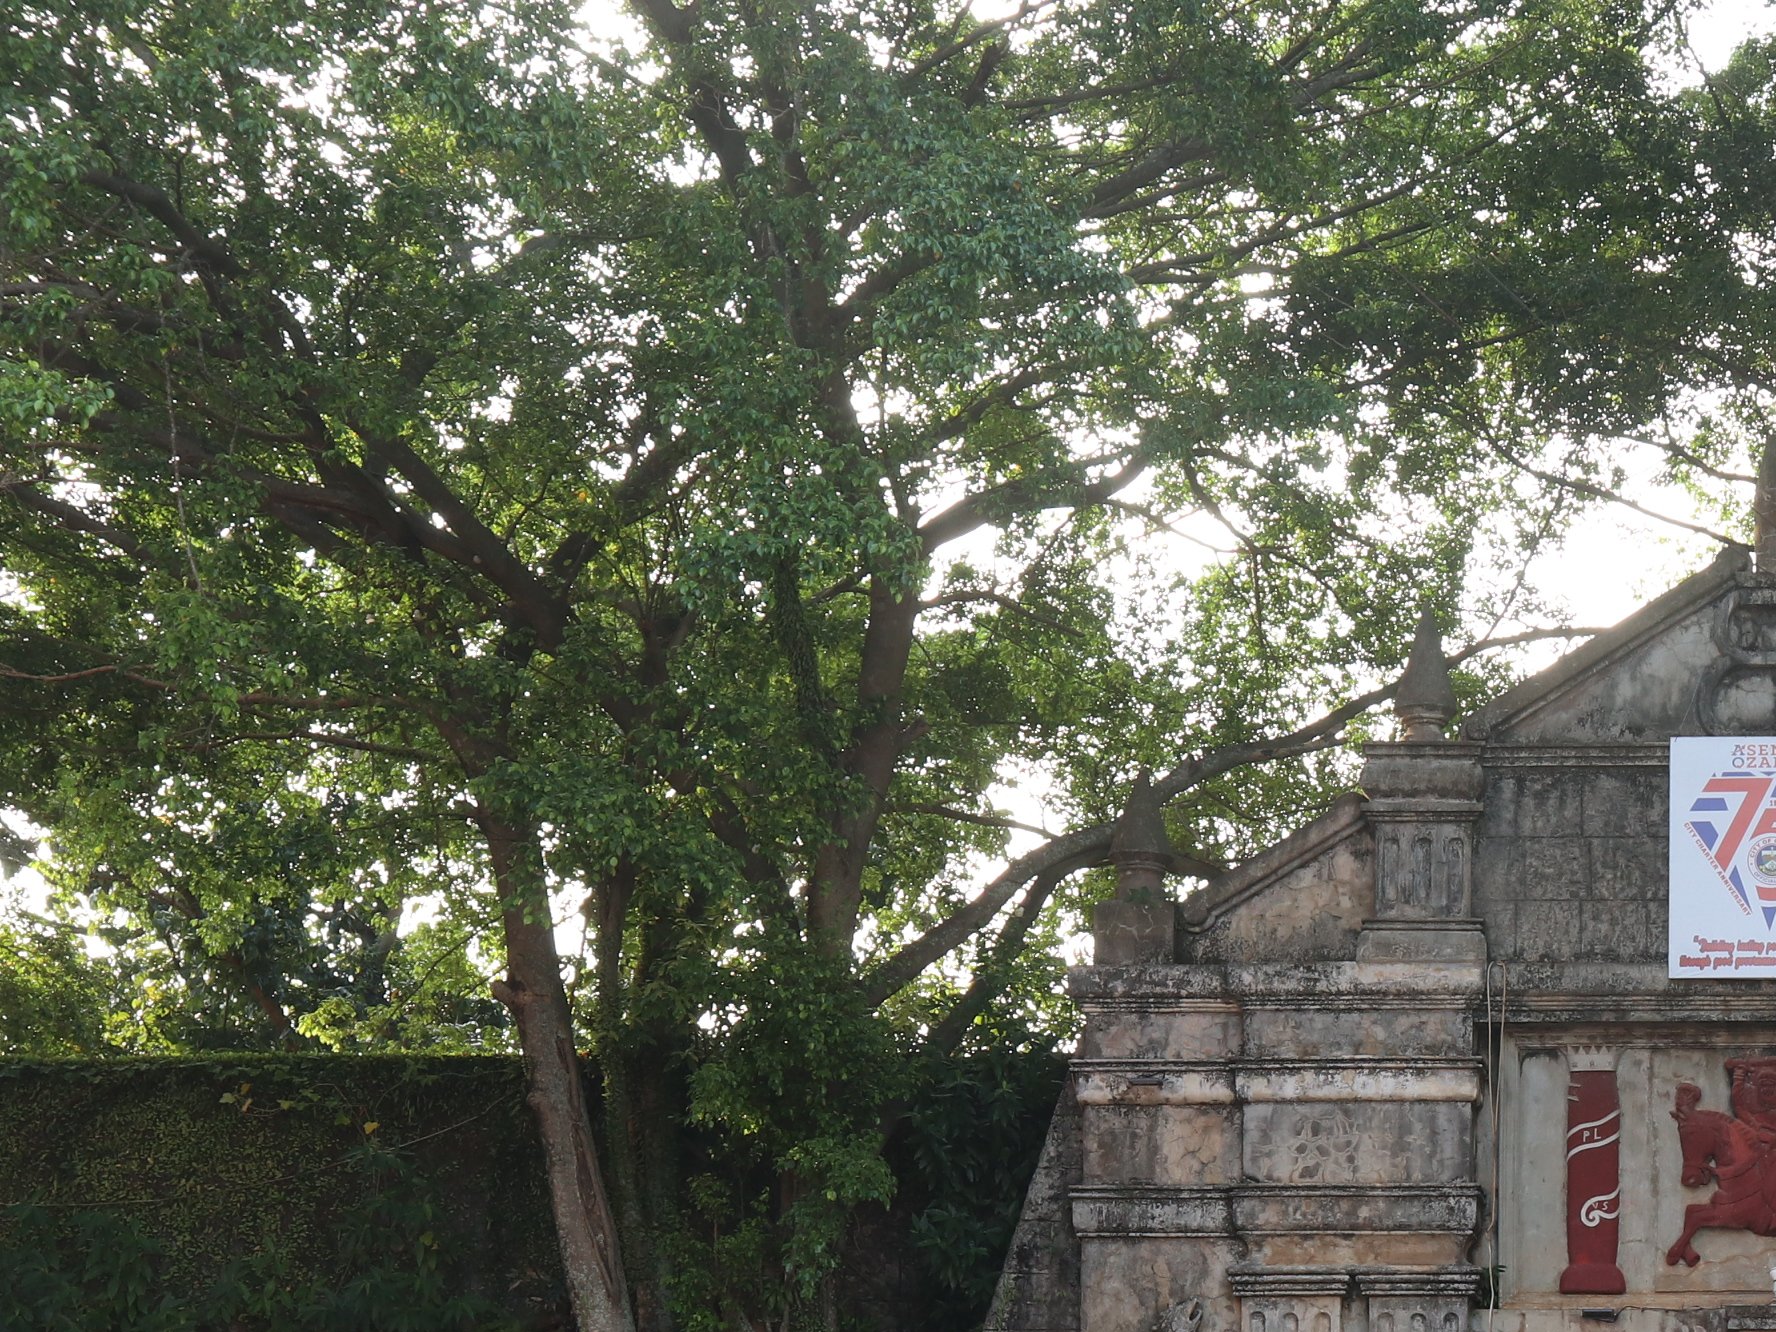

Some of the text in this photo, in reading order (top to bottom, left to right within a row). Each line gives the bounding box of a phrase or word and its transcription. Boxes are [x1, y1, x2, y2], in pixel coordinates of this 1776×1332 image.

[1750, 843, 1761, 858] CITY
[1683, 822, 1752, 917] CITY CHARTER ANNIVERSARY
[1583, 1128, 1601, 1142] PL
